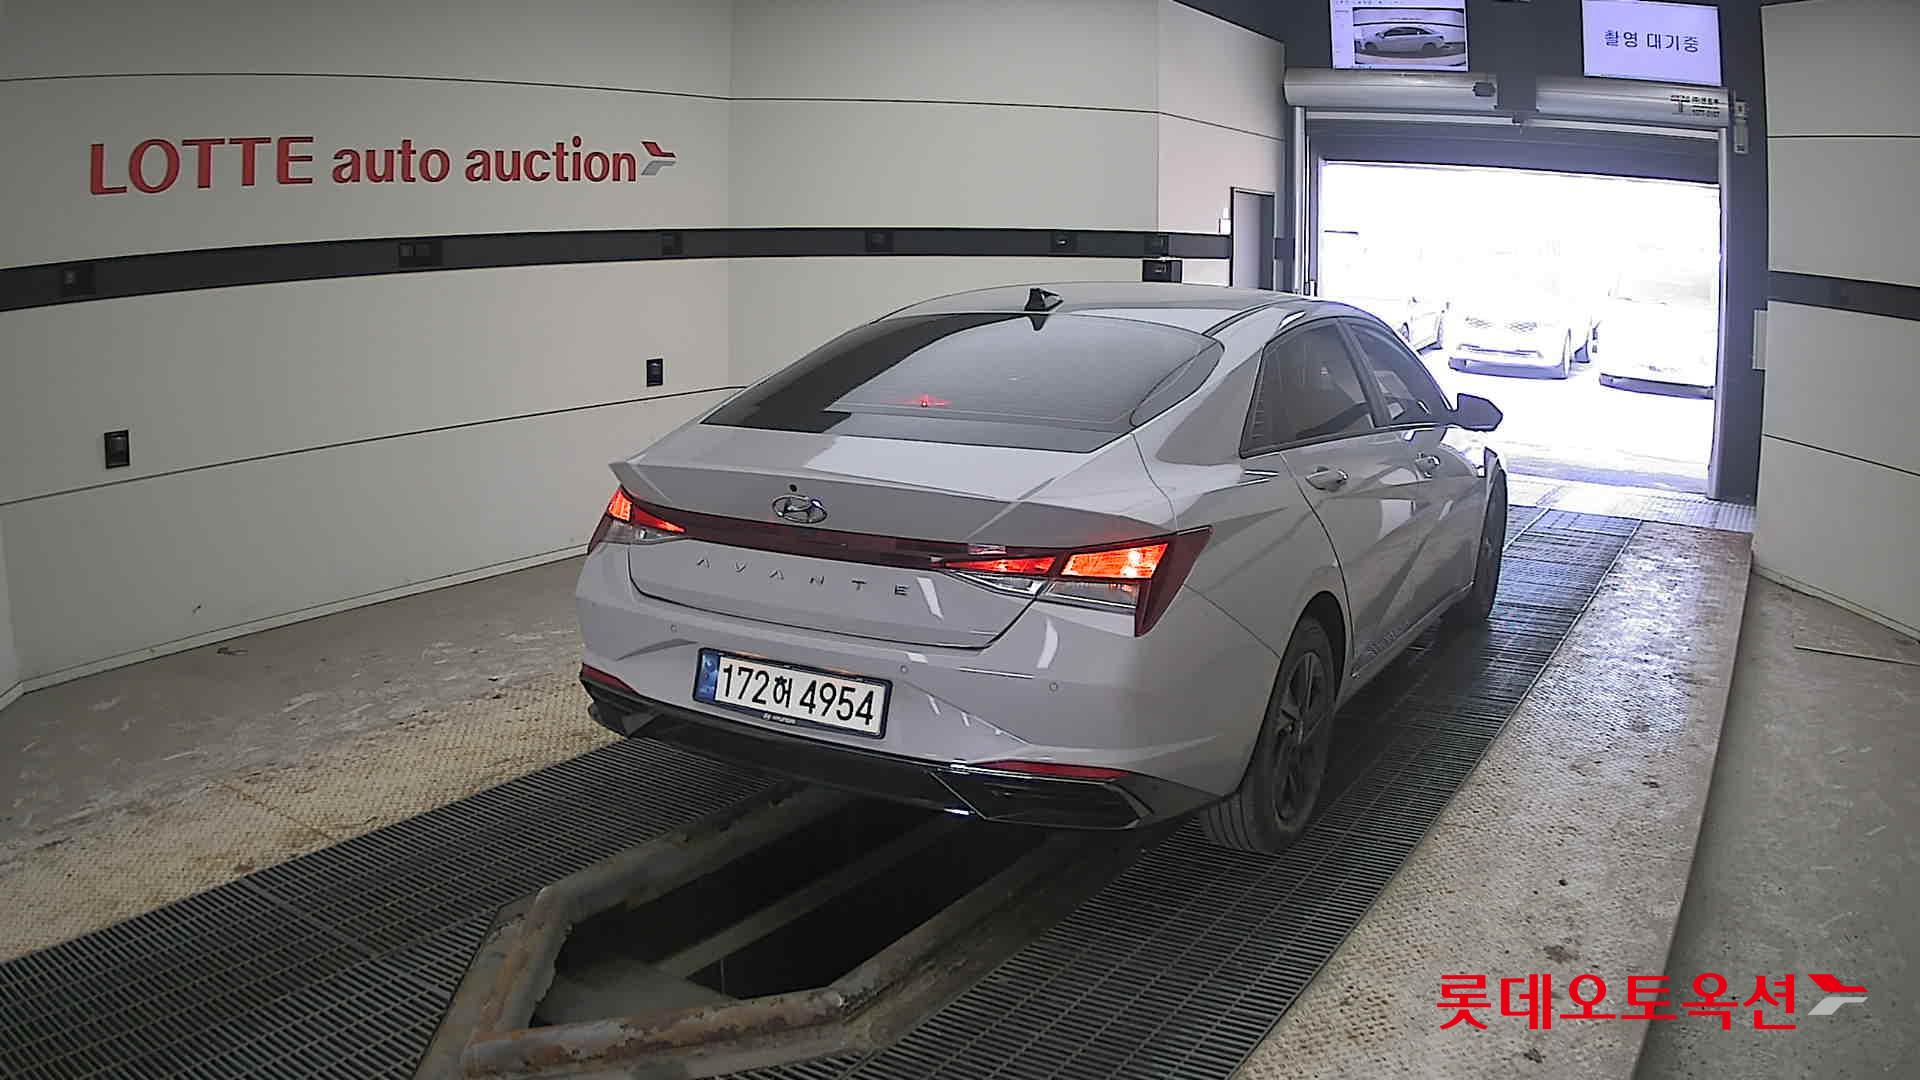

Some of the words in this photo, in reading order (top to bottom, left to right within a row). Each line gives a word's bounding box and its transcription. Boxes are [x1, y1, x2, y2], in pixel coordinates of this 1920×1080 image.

[1604, 30, 1638, 48] 촬영
[1646, 33, 1699, 53] 대기중
[90, 136, 314, 195] LOTTE
[331, 139, 450, 184] auto
[465, 135, 637, 183] auction
[696, 558, 909, 597] AVANTE
[722, 663, 793, 709] 172허
[799, 679, 874, 726] 4954
